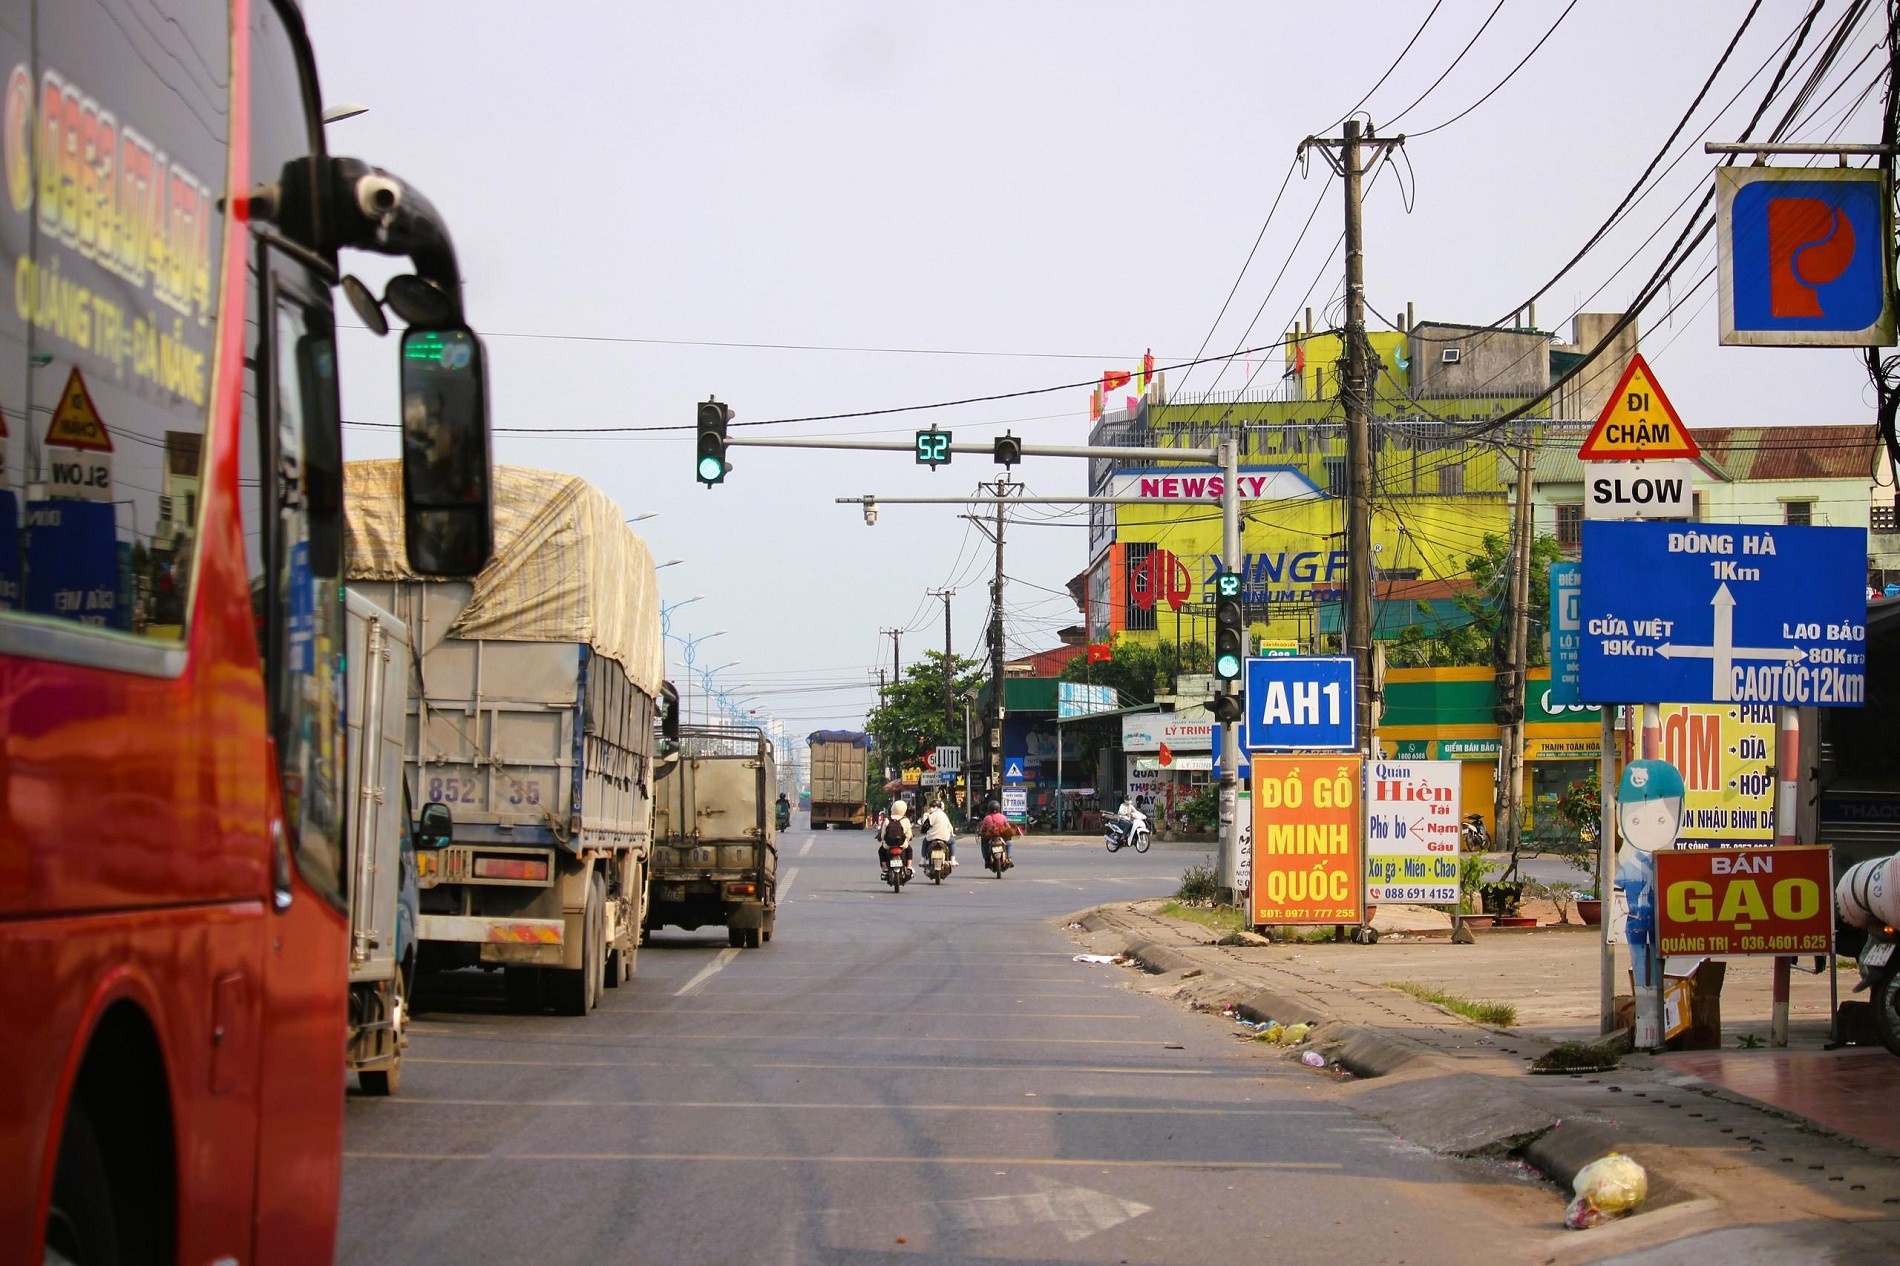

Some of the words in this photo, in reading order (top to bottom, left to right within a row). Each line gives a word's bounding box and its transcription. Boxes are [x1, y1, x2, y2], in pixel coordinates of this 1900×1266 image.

[1627, 393, 1649, 412] ĐI
[1606, 418, 1670, 446] CHẬM
[917, 434, 948, 461] 52
[1141, 476, 1267, 498] NEWSKY
[1593, 478, 1683, 504] SLOW
[1668, 531, 1732, 555] ĐÔNG
[1743, 531, 1777, 556] HÀ
[1711, 560, 1760, 582] 1Km
[1220, 577, 1238, 596] 52
[1588, 613, 1630, 638] CỬA
[1633, 617, 1674, 639] VIỆT
[1783, 623, 1821, 640] LAO
[1825, 618, 1866, 641] BẢO
[1600, 639, 1655, 658] 19Km
[1808, 647, 1866, 665] 80Km
[1262, 681, 1340, 726] AH1
[1541, 743, 1565, 751] THANH
[1740, 735, 1767, 759] DĨA
[1375, 764, 1411, 782] Quán
[509, 779, 540, 806] 35
[1262, 768, 1303, 808] ĐỒ
[1313, 766, 1353, 809] GỖ
[1374, 779, 1453, 802] Hiền
[1740, 771, 1771, 799] HỘP
[1429, 803, 1450, 815] Tái
[1697, 806, 1728, 833] NHẬU
[1731, 807, 1758, 829] BÌNH
[1370, 814, 1389, 840] Phở
[1395, 814, 1407, 840] bò
[1427, 822, 1458, 836] Nạm
[1267, 823, 1349, 855] MINH
[1368, 859, 1384, 878] Xôi
[1385, 859, 1396, 884] gà
[1404, 856, 1426, 878] Miến
[1434, 858, 1456, 879] Cháo
[1711, 852, 1773, 875] BÁN
[1267, 859, 1349, 905] QUỐC
[1385, 888, 1405, 900] 088
[1407, 888, 1427, 900] 691
[1429, 888, 1455, 900] 4152
[1666, 879, 1820, 931] GẠO
[1260, 908, 1282, 918] SĐT:
[1285, 908, 1311, 918] 0971
[1313, 908, 1333, 918] 777
[1335, 908, 1355, 918] 255
[1661, 934, 1705, 955] QUẢNG
[1708, 934, 1728, 956] TRỊ
[1741, 934, 1827, 951] 036.4601.625
